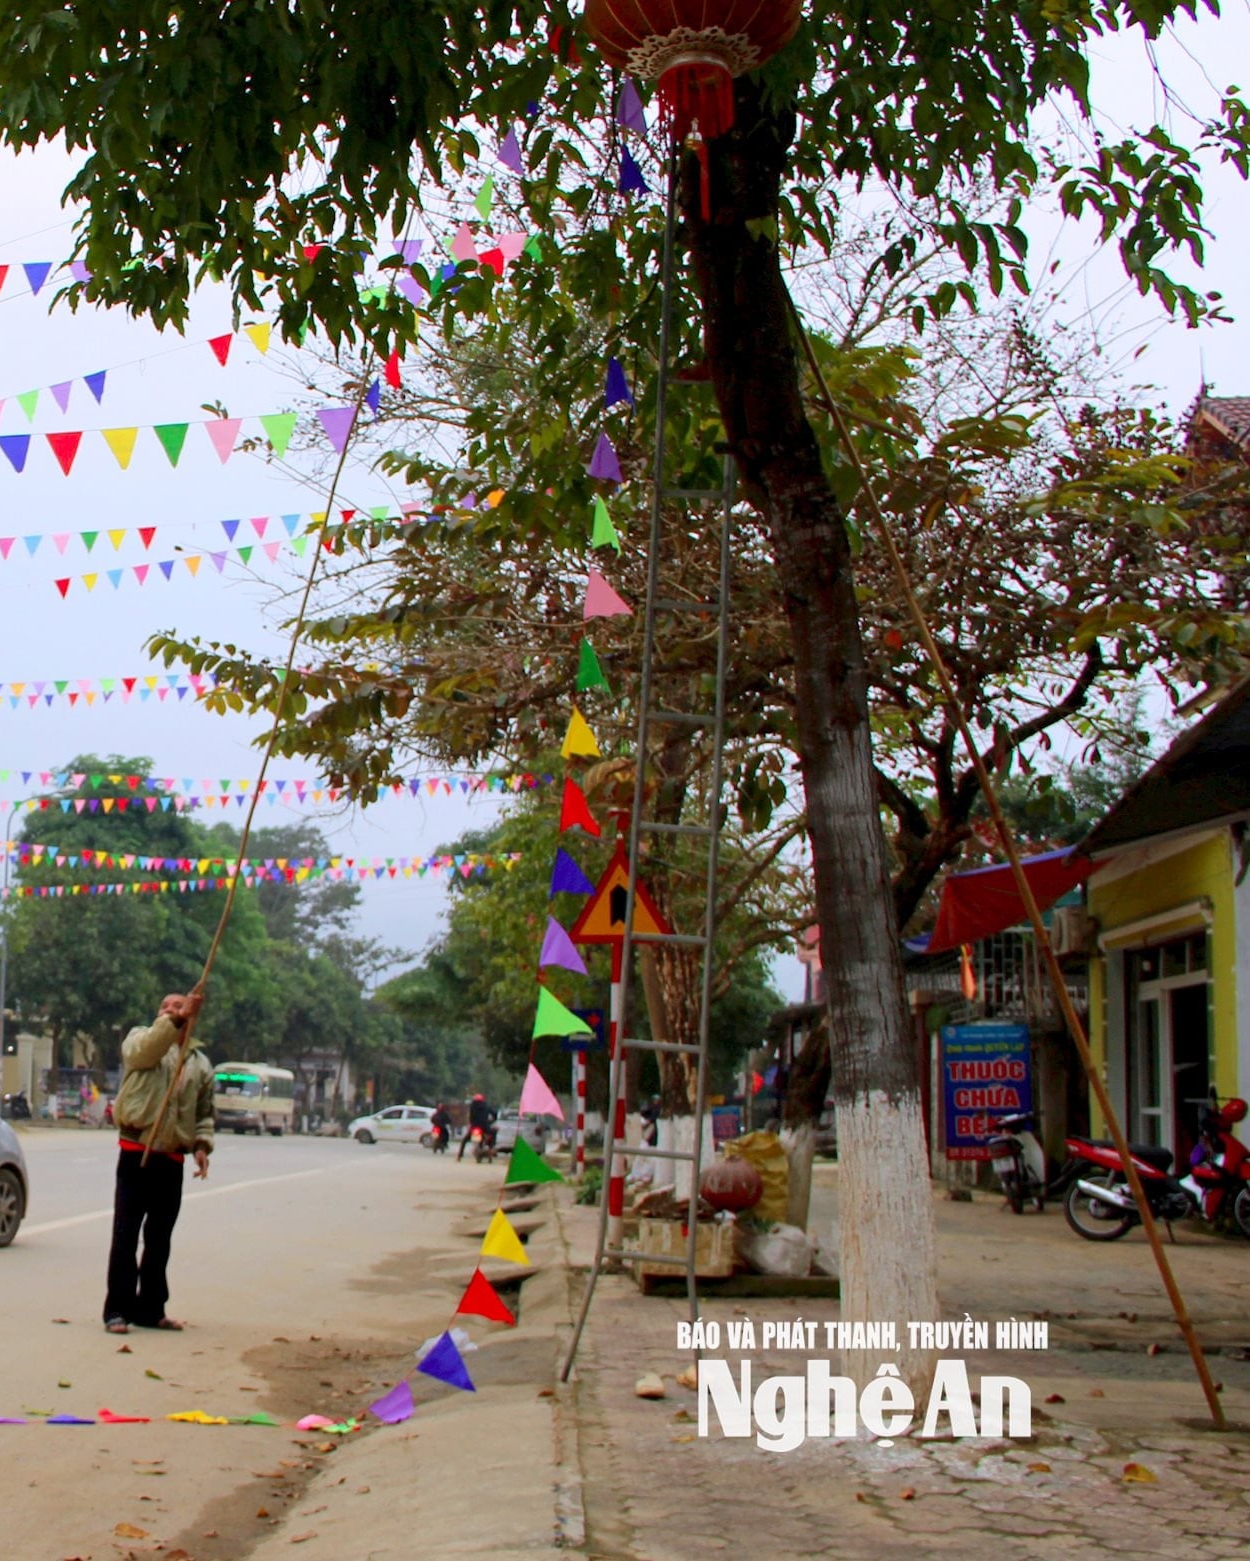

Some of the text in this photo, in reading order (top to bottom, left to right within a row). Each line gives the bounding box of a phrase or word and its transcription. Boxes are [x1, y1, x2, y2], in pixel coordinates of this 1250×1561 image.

[948, 1054, 1025, 1081] THUỐC
[955, 1083, 1020, 1109] CHỮA
[956, 1111, 1015, 1140] BỆN
